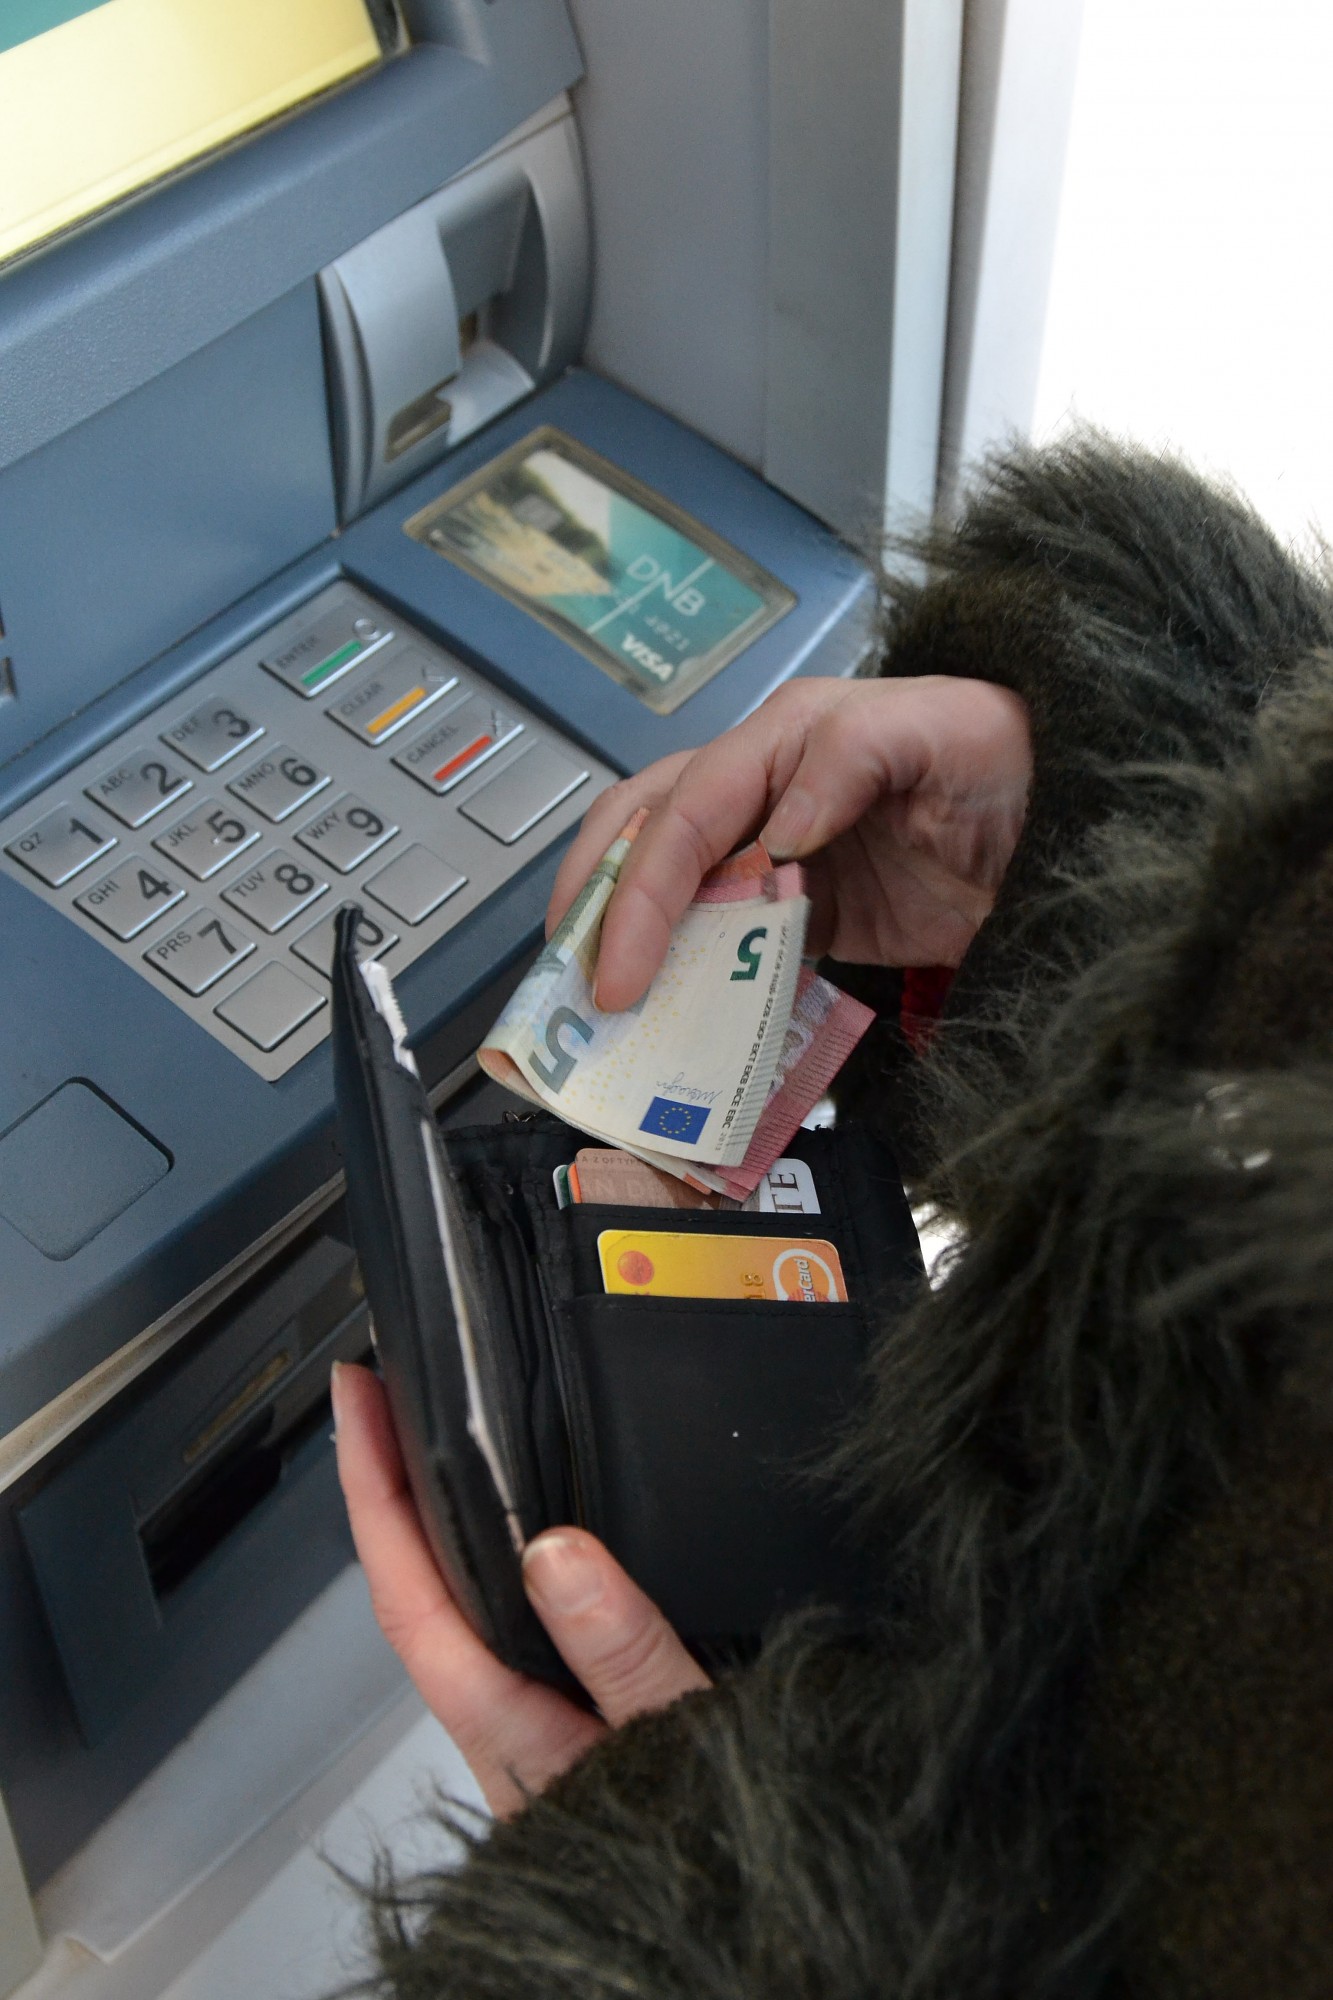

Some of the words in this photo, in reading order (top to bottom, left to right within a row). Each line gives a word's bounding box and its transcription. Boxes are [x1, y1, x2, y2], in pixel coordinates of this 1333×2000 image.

[626, 554, 706, 616] DNB
[275, 635, 318, 668] ENTER
[621, 632, 673, 682] VISA
[340, 681, 384, 715] CLEAR
[213, 709, 249, 738] 3
[407, 725, 458, 764] CANCEL
[99, 769, 132, 797] ABC
[140, 762, 184, 795] 2
[238, 762, 276, 792] MNO
[280, 758, 316, 786] 6
[19, 832, 42, 852] QZ
[70, 818, 103, 844] 1
[168, 823, 198, 848] JKL
[207, 810, 246, 843] 5
[307, 811, 341, 840] WXY
[346, 807, 384, 838] 9
[88, 879, 121, 906] GHI
[137, 869, 173, 900] 4
[233, 871, 266, 899] TUV
[274, 864, 314, 896] 8
[157, 931, 192, 960] PRS
[197, 919, 238, 955] 7
[730, 926, 767, 981] 5
[528, 1006, 595, 1095] 5
[748, 1043, 760, 1062] EKT
[740, 1065, 752, 1084] EKB
[722, 1109, 736, 1129] EBC
